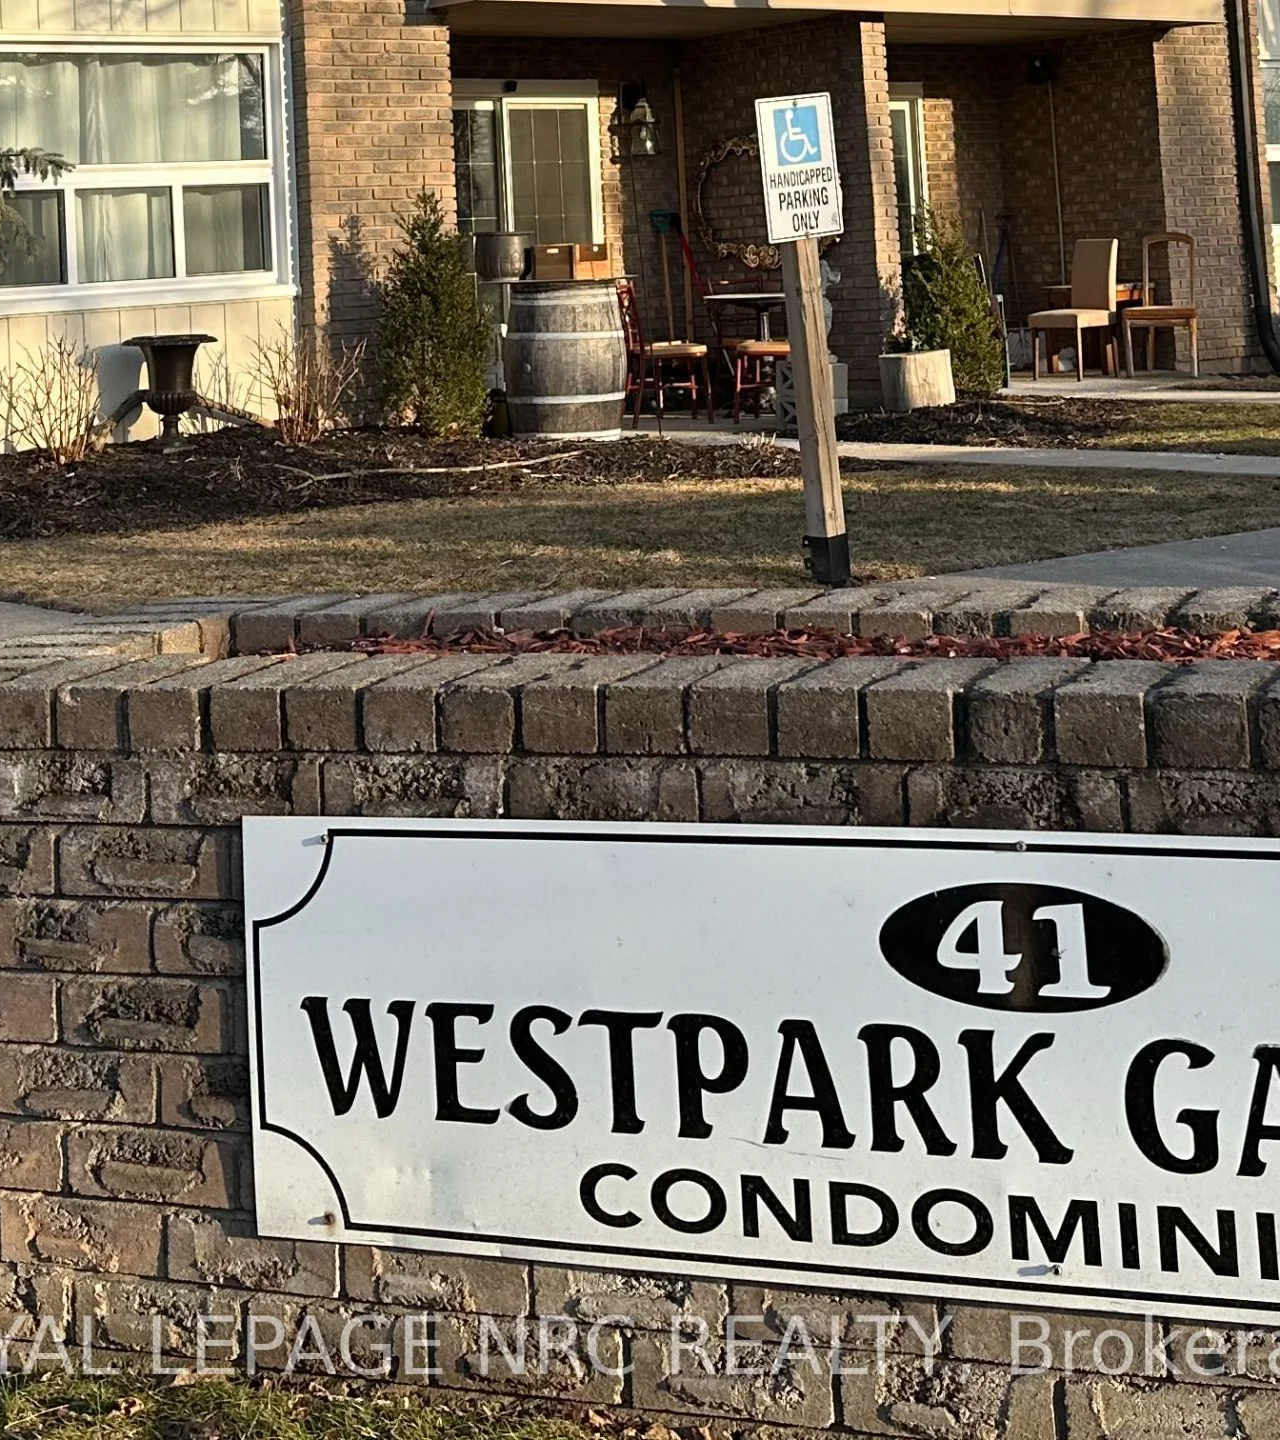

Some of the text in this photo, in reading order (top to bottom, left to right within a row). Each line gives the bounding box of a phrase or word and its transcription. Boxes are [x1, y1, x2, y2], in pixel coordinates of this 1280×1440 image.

[769, 166, 833, 189] HANDICAPPED
[778, 186, 829, 212] PARKING
[792, 210, 820, 233] ONLY
[936, 900, 1111, 999] 41
[300, 997, 1074, 1165] WESTPARK
